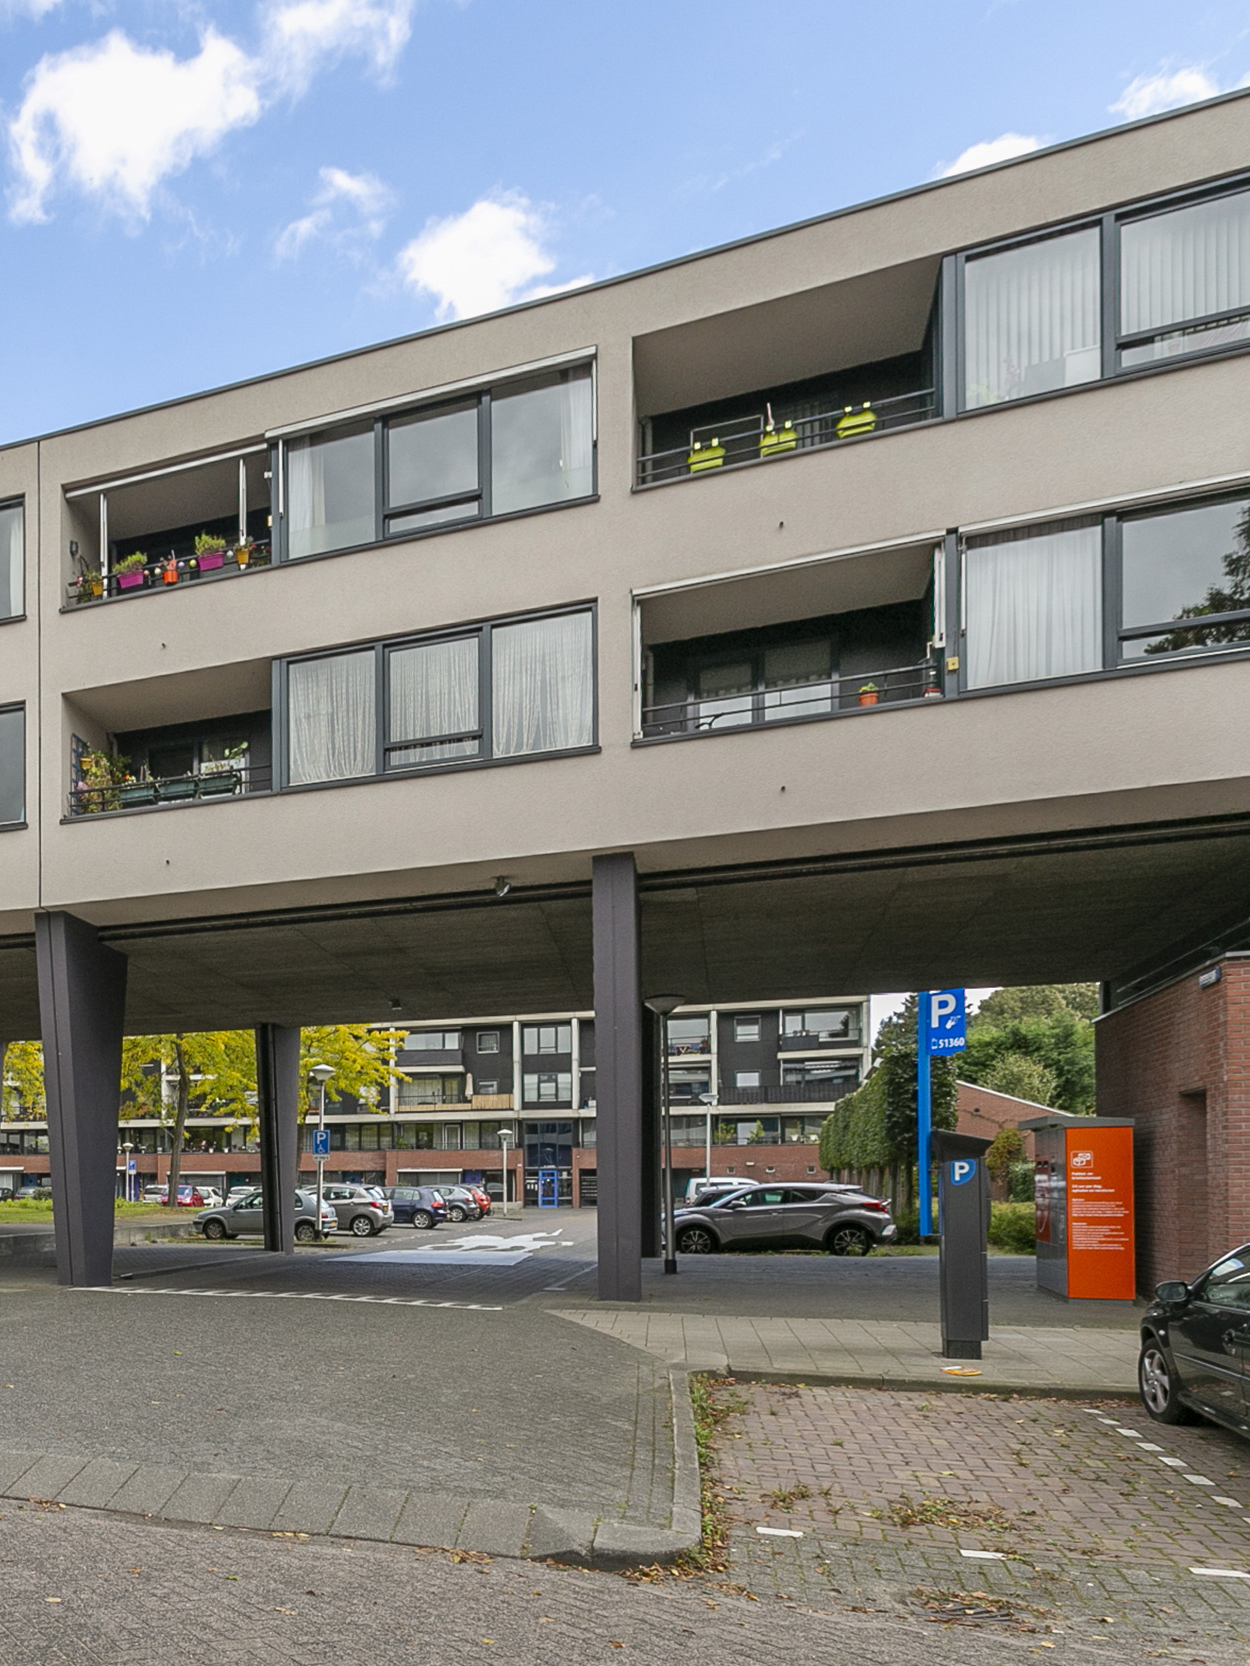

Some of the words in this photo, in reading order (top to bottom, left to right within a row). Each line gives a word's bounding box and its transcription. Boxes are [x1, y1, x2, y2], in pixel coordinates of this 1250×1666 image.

[931, 994, 956, 1028] P
[939, 1037, 965, 1048] 51360
[317, 1132, 326, 1144] P
[954, 1161, 970, 1181] P
